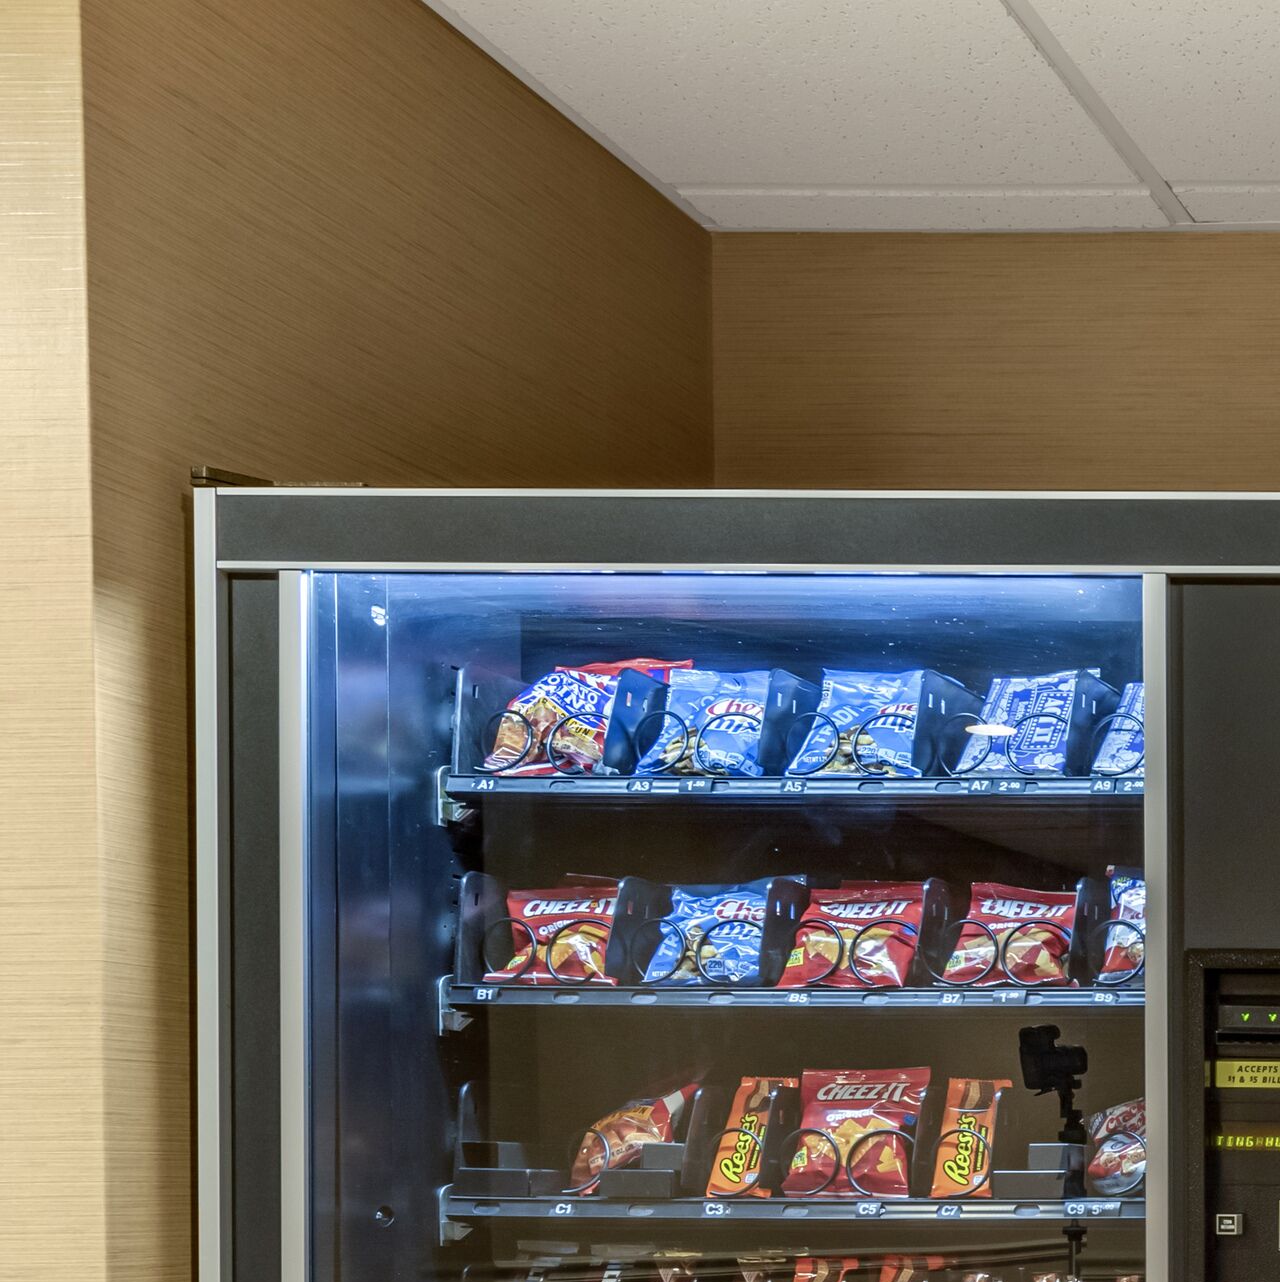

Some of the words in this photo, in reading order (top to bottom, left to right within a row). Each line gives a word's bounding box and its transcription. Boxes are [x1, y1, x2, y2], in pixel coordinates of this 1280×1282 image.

[478, 779, 495, 790] A1
[632, 780, 650, 791] A3
[783, 781, 802, 792] A5
[972, 780, 989, 791] A7
[1094, 781, 1111, 791] A9
[477, 988, 493, 1000] B1
[789, 993, 808, 1003] B5
[942, 993, 960, 1004] B7
[1094, 992, 1113, 1003] B9
[1237, 1065, 1279, 1073] ACCEPTS
[1228, 1075, 1236, 1083] $1
[1239, 1076, 1245, 1084] &
[1249, 1076, 1258, 1084] $5
[816, 1082, 910, 1102] CHEEZ-IT
[720, 1112, 759, 1184] Reese's
[943, 1113, 976, 1186] Reese's
[555, 1204, 572, 1214] C1
[706, 1204, 724, 1215] C3
[859, 1204, 877, 1215] C5
[941, 1205, 958, 1216] C7
[1067, 1204, 1085, 1215] C9
